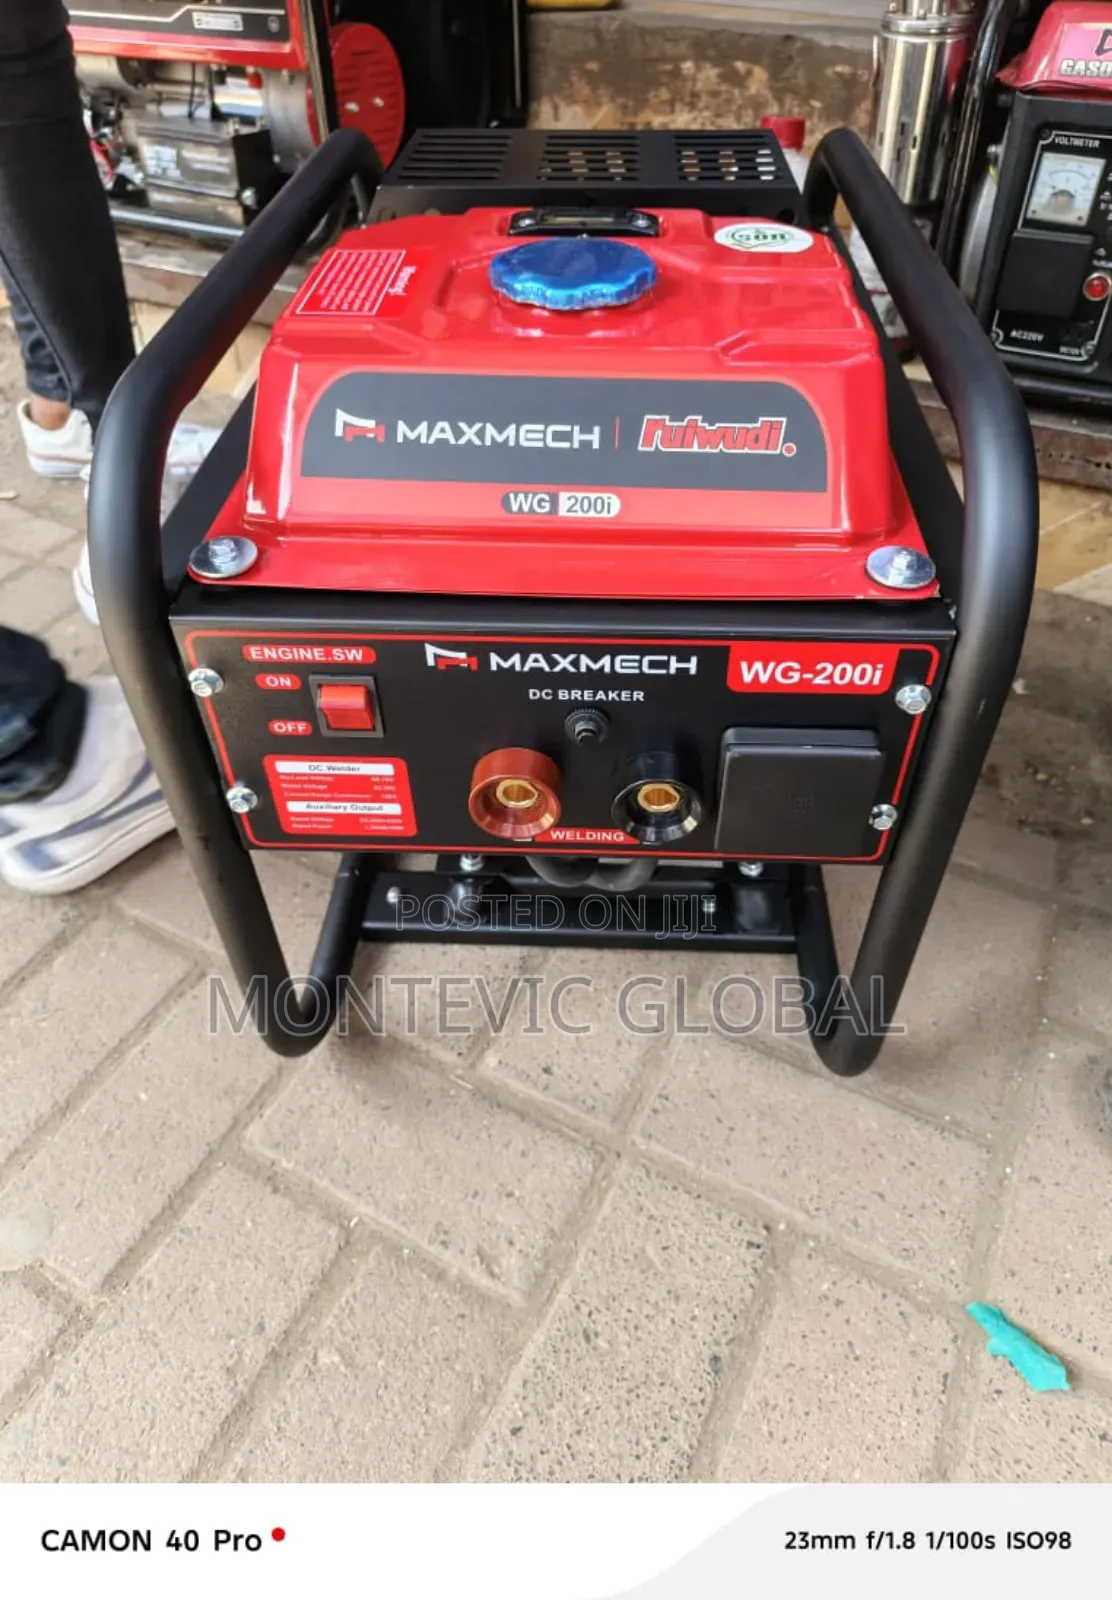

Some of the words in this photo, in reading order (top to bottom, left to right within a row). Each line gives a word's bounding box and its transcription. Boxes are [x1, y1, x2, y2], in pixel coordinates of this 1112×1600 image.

[1054, 136, 1100, 148] VOLTMETER
[396, 420, 600, 450] MAXMECH
[508, 494, 551, 514] WG
[565, 495, 612, 515] 200i
[249, 646, 364, 662] ENGINE.SW
[489, 652, 698, 675] MAXMECH
[739, 661, 884, 685] WG-200i
[265, 676, 292, 687] ON
[528, 688, 554, 701] DC
[558, 689, 645, 703] BREAKER
[273, 722, 308, 733] OFF
[306, 803, 348, 812] Auxiliary
[350, 804, 384, 812] Output
[550, 830, 626, 842] WELDING
